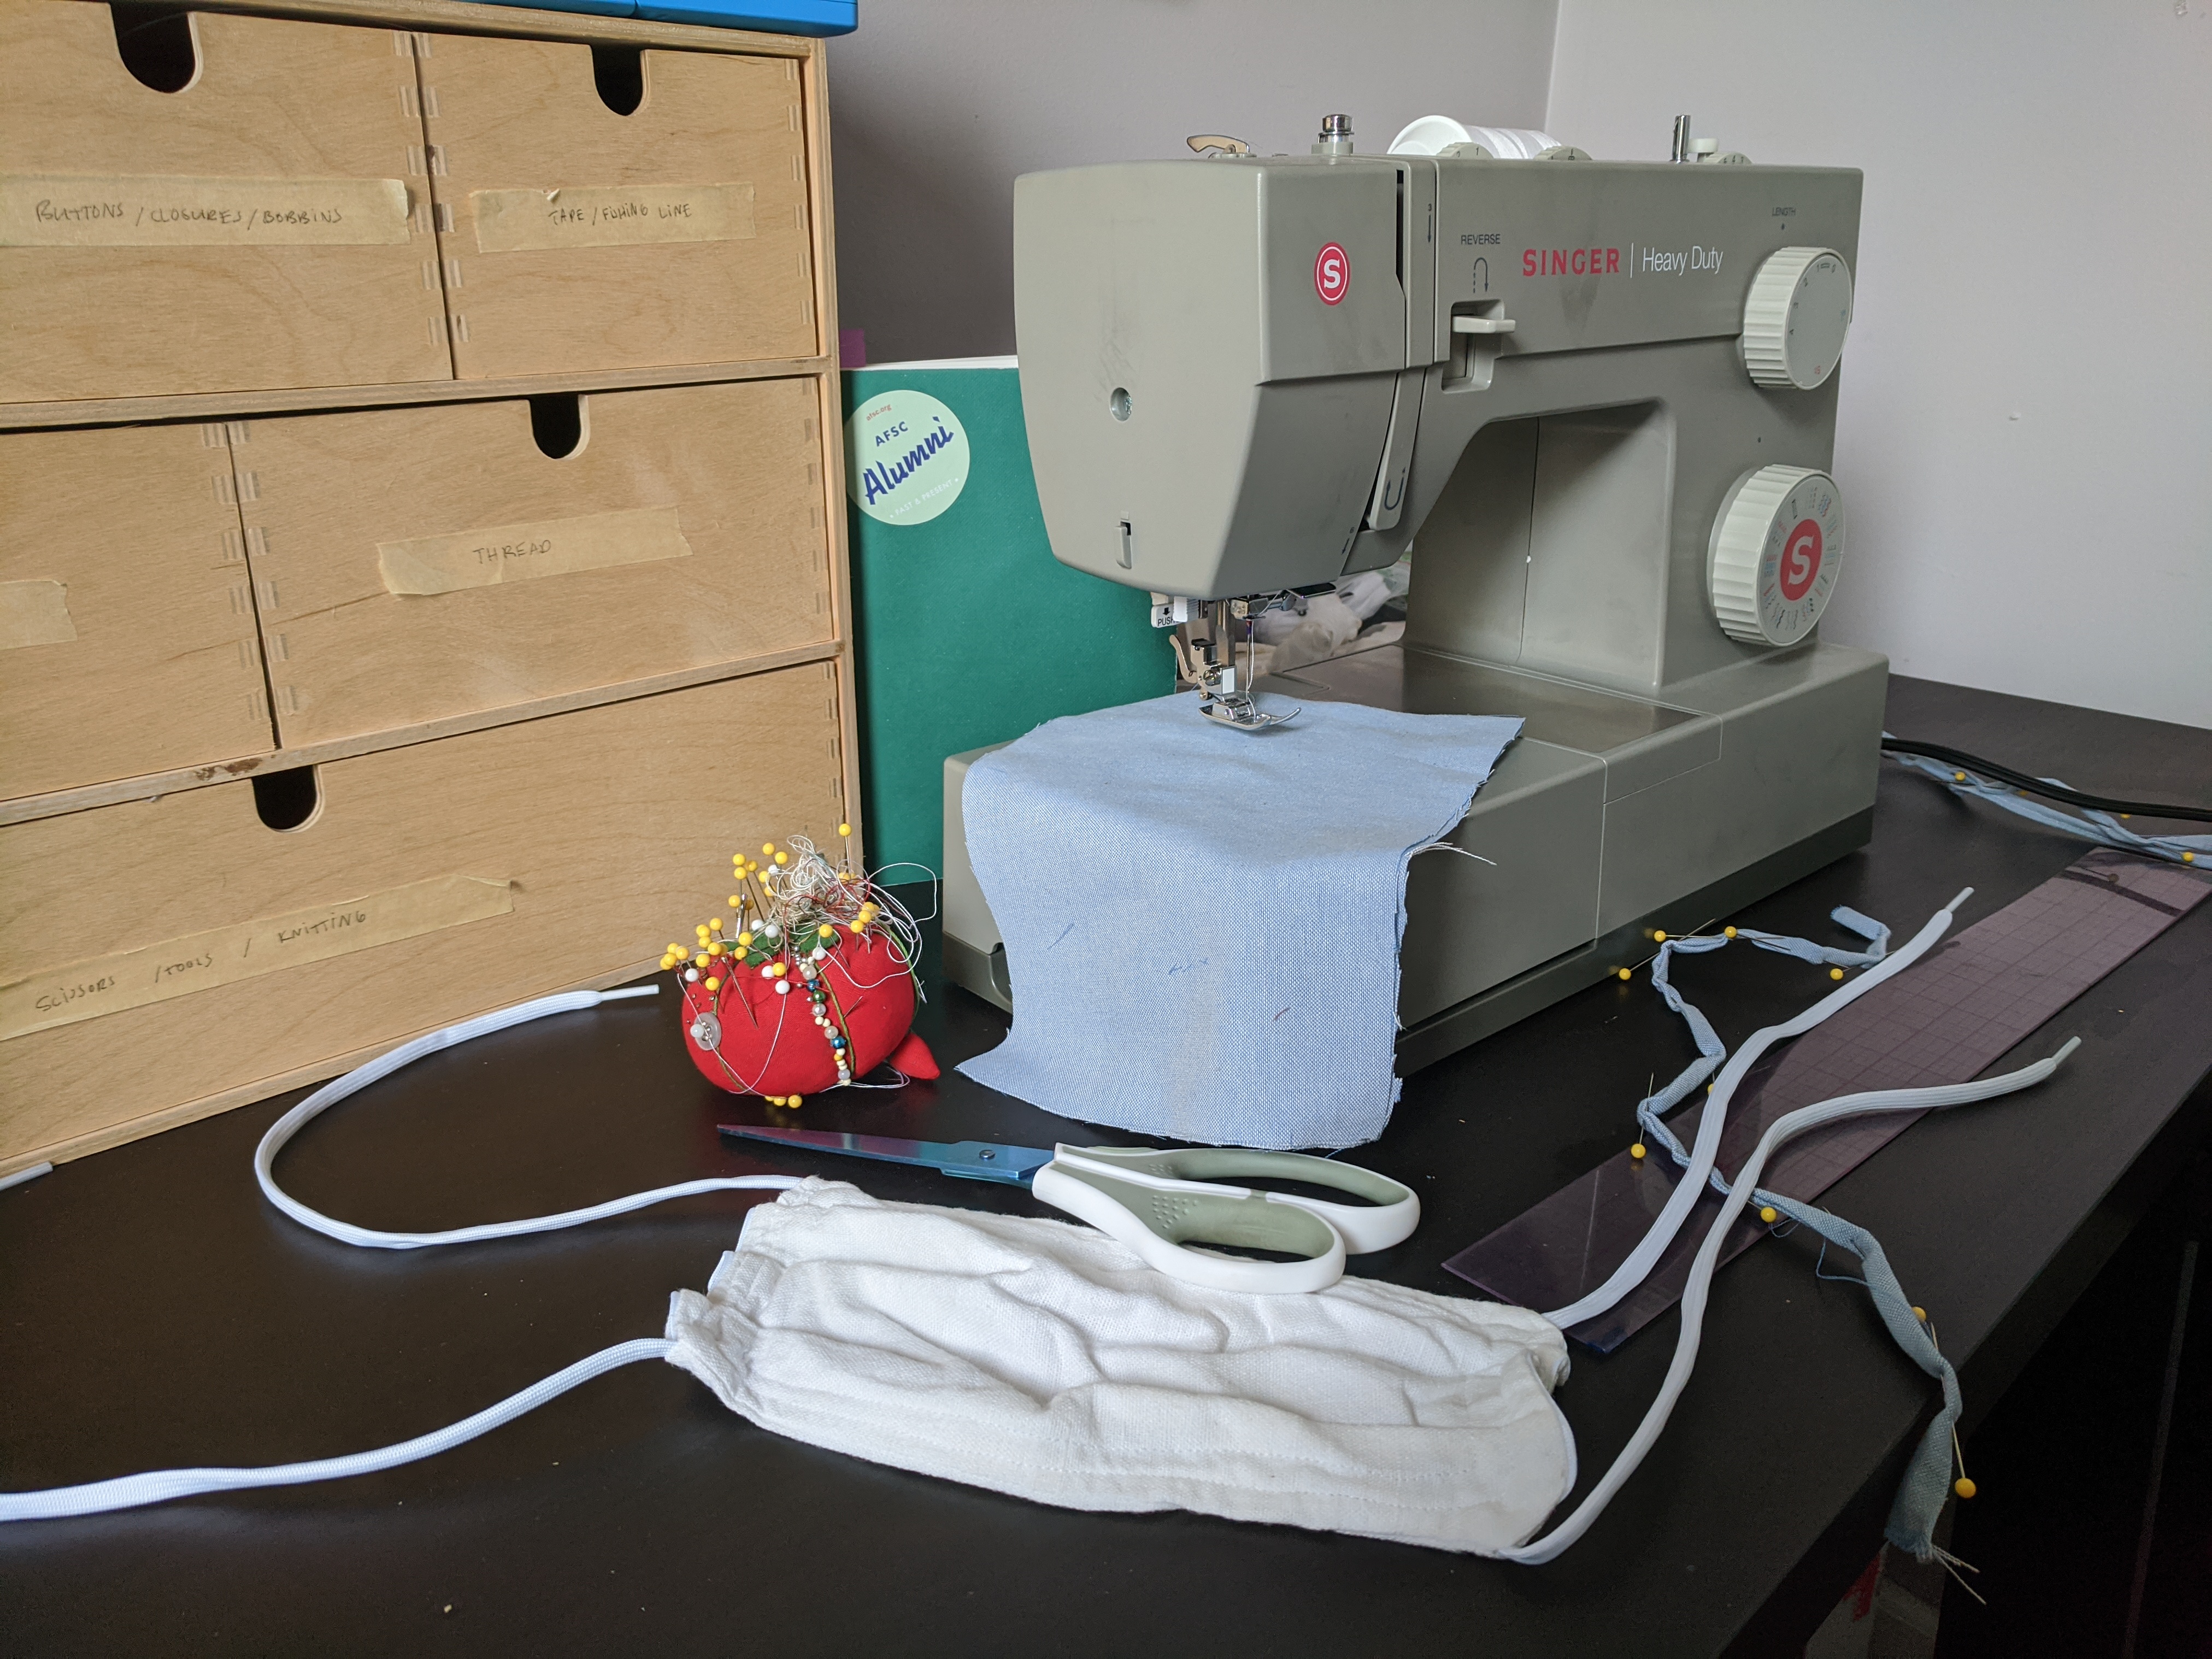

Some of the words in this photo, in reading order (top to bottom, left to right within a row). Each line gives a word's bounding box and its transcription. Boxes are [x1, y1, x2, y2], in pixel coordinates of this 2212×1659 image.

[36, 199, 124, 223] BUTTONS
[548, 208, 585, 226] TAPE
[1427, 203, 1432, 211] 3
[1461, 233, 1501, 245] REVERSE
[1522, 248, 1620, 277] SINGER
[1642, 246, 1688, 276] Heavy
[1691, 245, 1723, 274] Duty
[875, 421, 909, 447] AFSC
[862, 416, 955, 505] Alumni
[472, 539, 552, 564] THREAD
[278, 911, 366, 944] KNITTING
